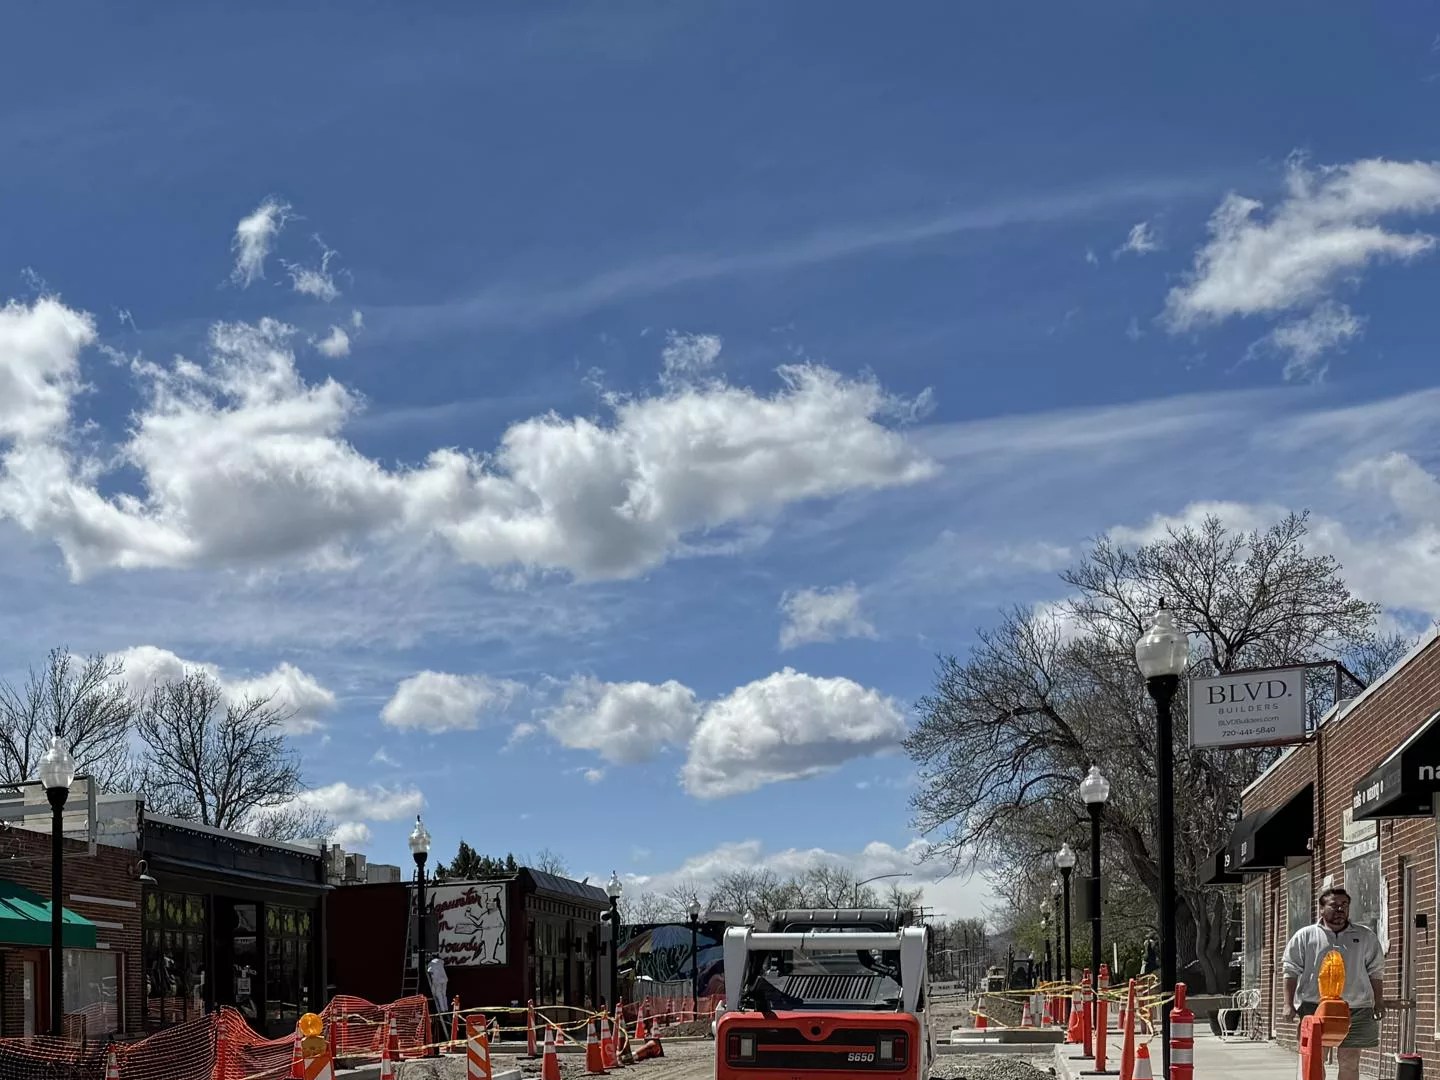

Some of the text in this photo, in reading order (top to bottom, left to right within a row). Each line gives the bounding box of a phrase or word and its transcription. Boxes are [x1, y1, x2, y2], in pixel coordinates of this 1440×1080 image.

[1207, 680, 1292, 704] BLVD.
[1218, 703, 1280, 714] BUILDERS
[1222, 726, 1276, 738] 720-441-5840
[847, 1052, 874, 1062] S650
